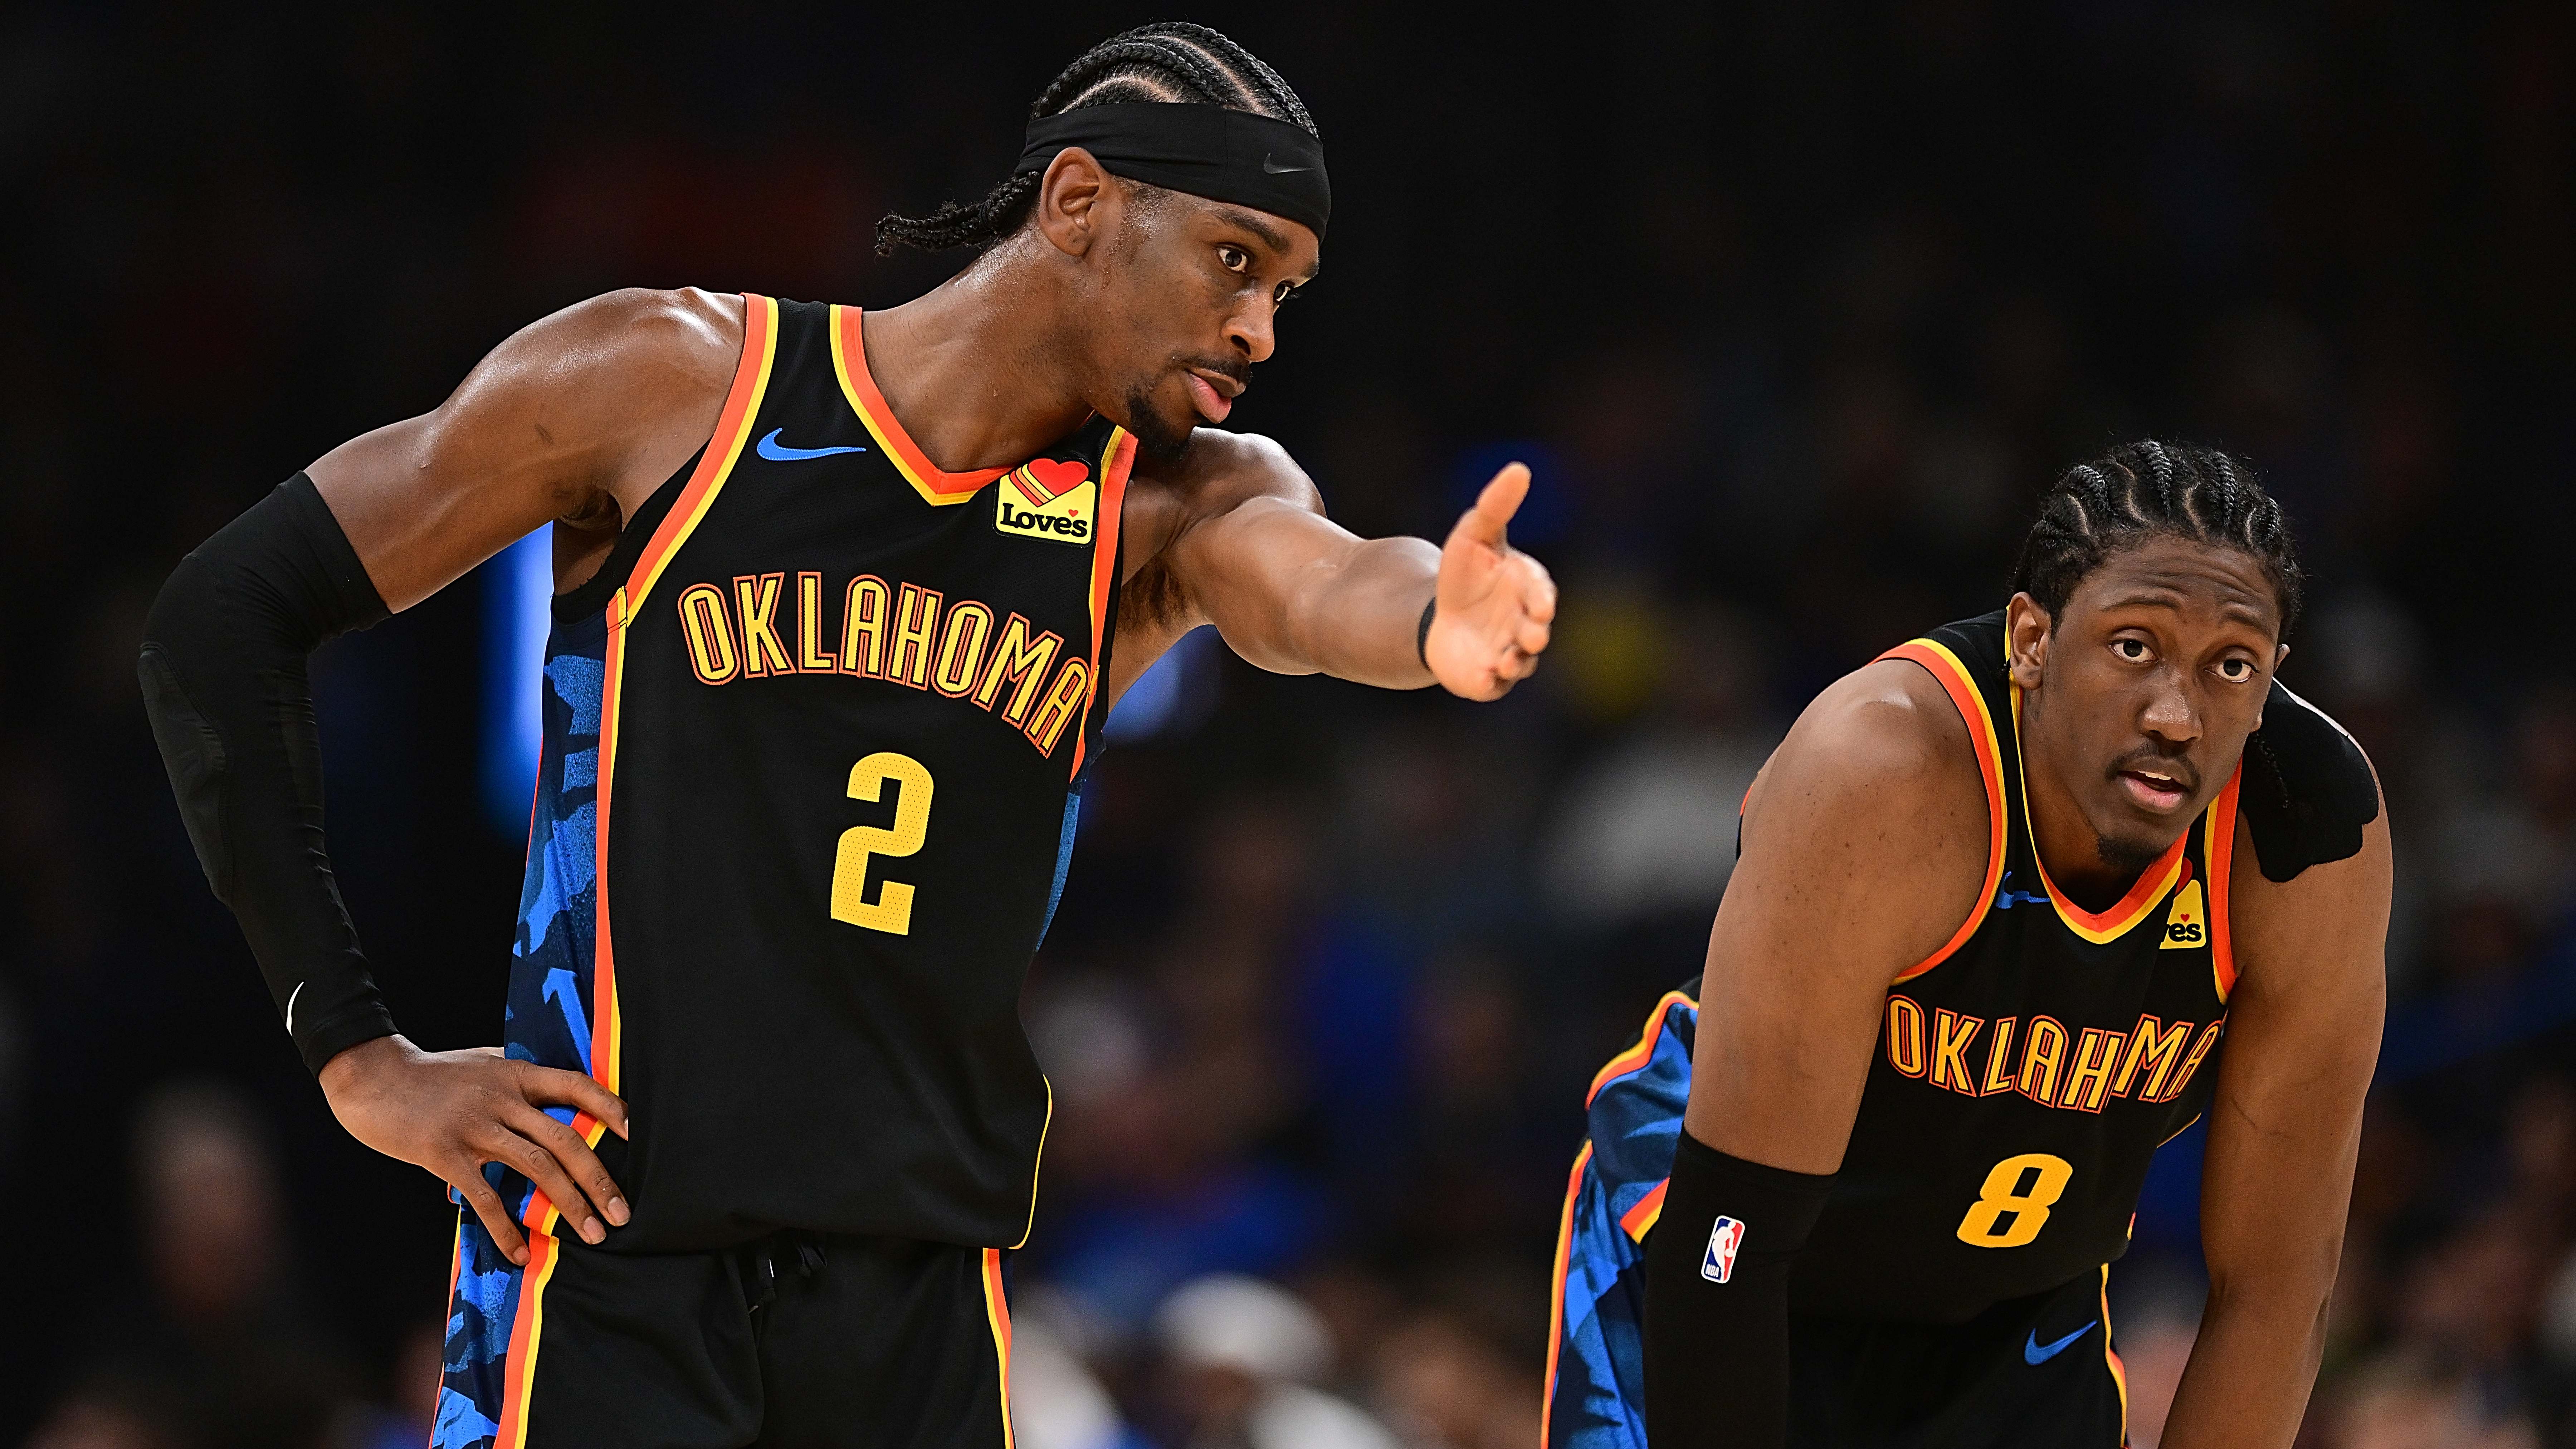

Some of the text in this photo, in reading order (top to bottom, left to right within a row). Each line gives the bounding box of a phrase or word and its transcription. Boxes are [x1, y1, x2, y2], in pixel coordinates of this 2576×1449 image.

[1000, 503, 1087, 537] Loves
[678, 571, 1090, 758] OKLAHOMA
[831, 752, 934, 936] 2
[1885, 994, 2222, 1114] OKLAHMA
[1957, 1153, 2073, 1248] 8
[1705, 1264, 1719, 1278] NBA
